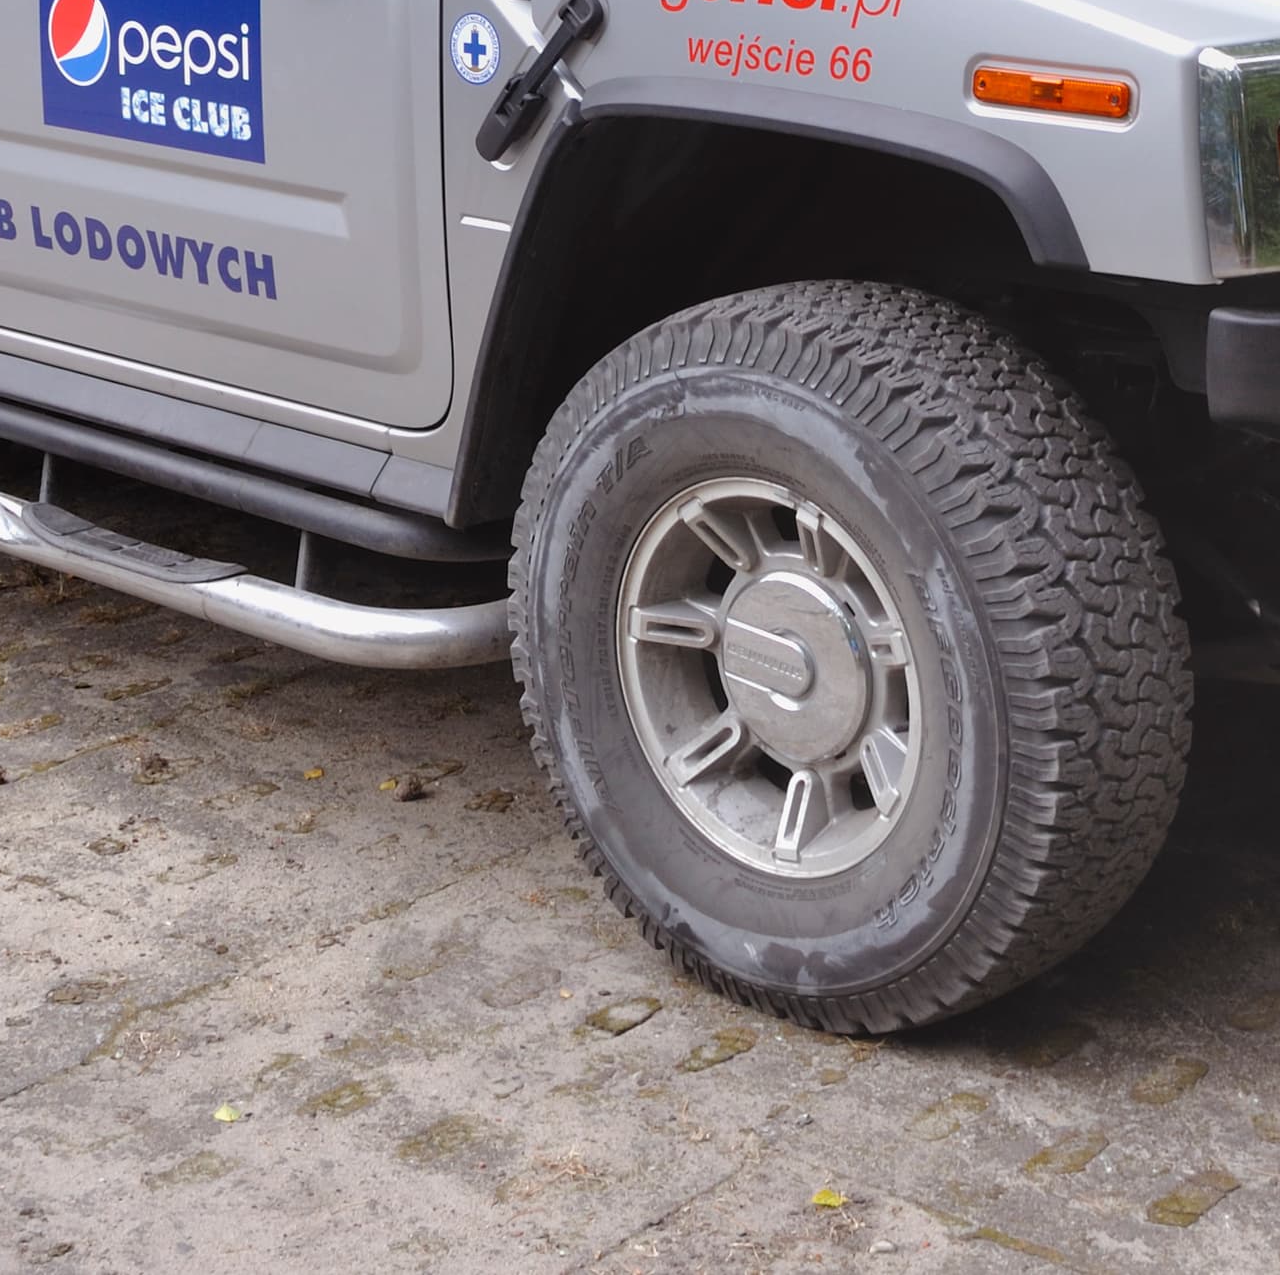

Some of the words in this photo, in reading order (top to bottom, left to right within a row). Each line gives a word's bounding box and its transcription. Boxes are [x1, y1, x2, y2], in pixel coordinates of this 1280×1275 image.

[118, 20, 250, 86] pepsi
[687, 34, 815, 77] wejście
[829, 44, 873, 83] 66
[120, 86, 166, 126] ICE
[172, 97, 252, 141] CLUB
[30, 205, 278, 301] LODOWYCH
